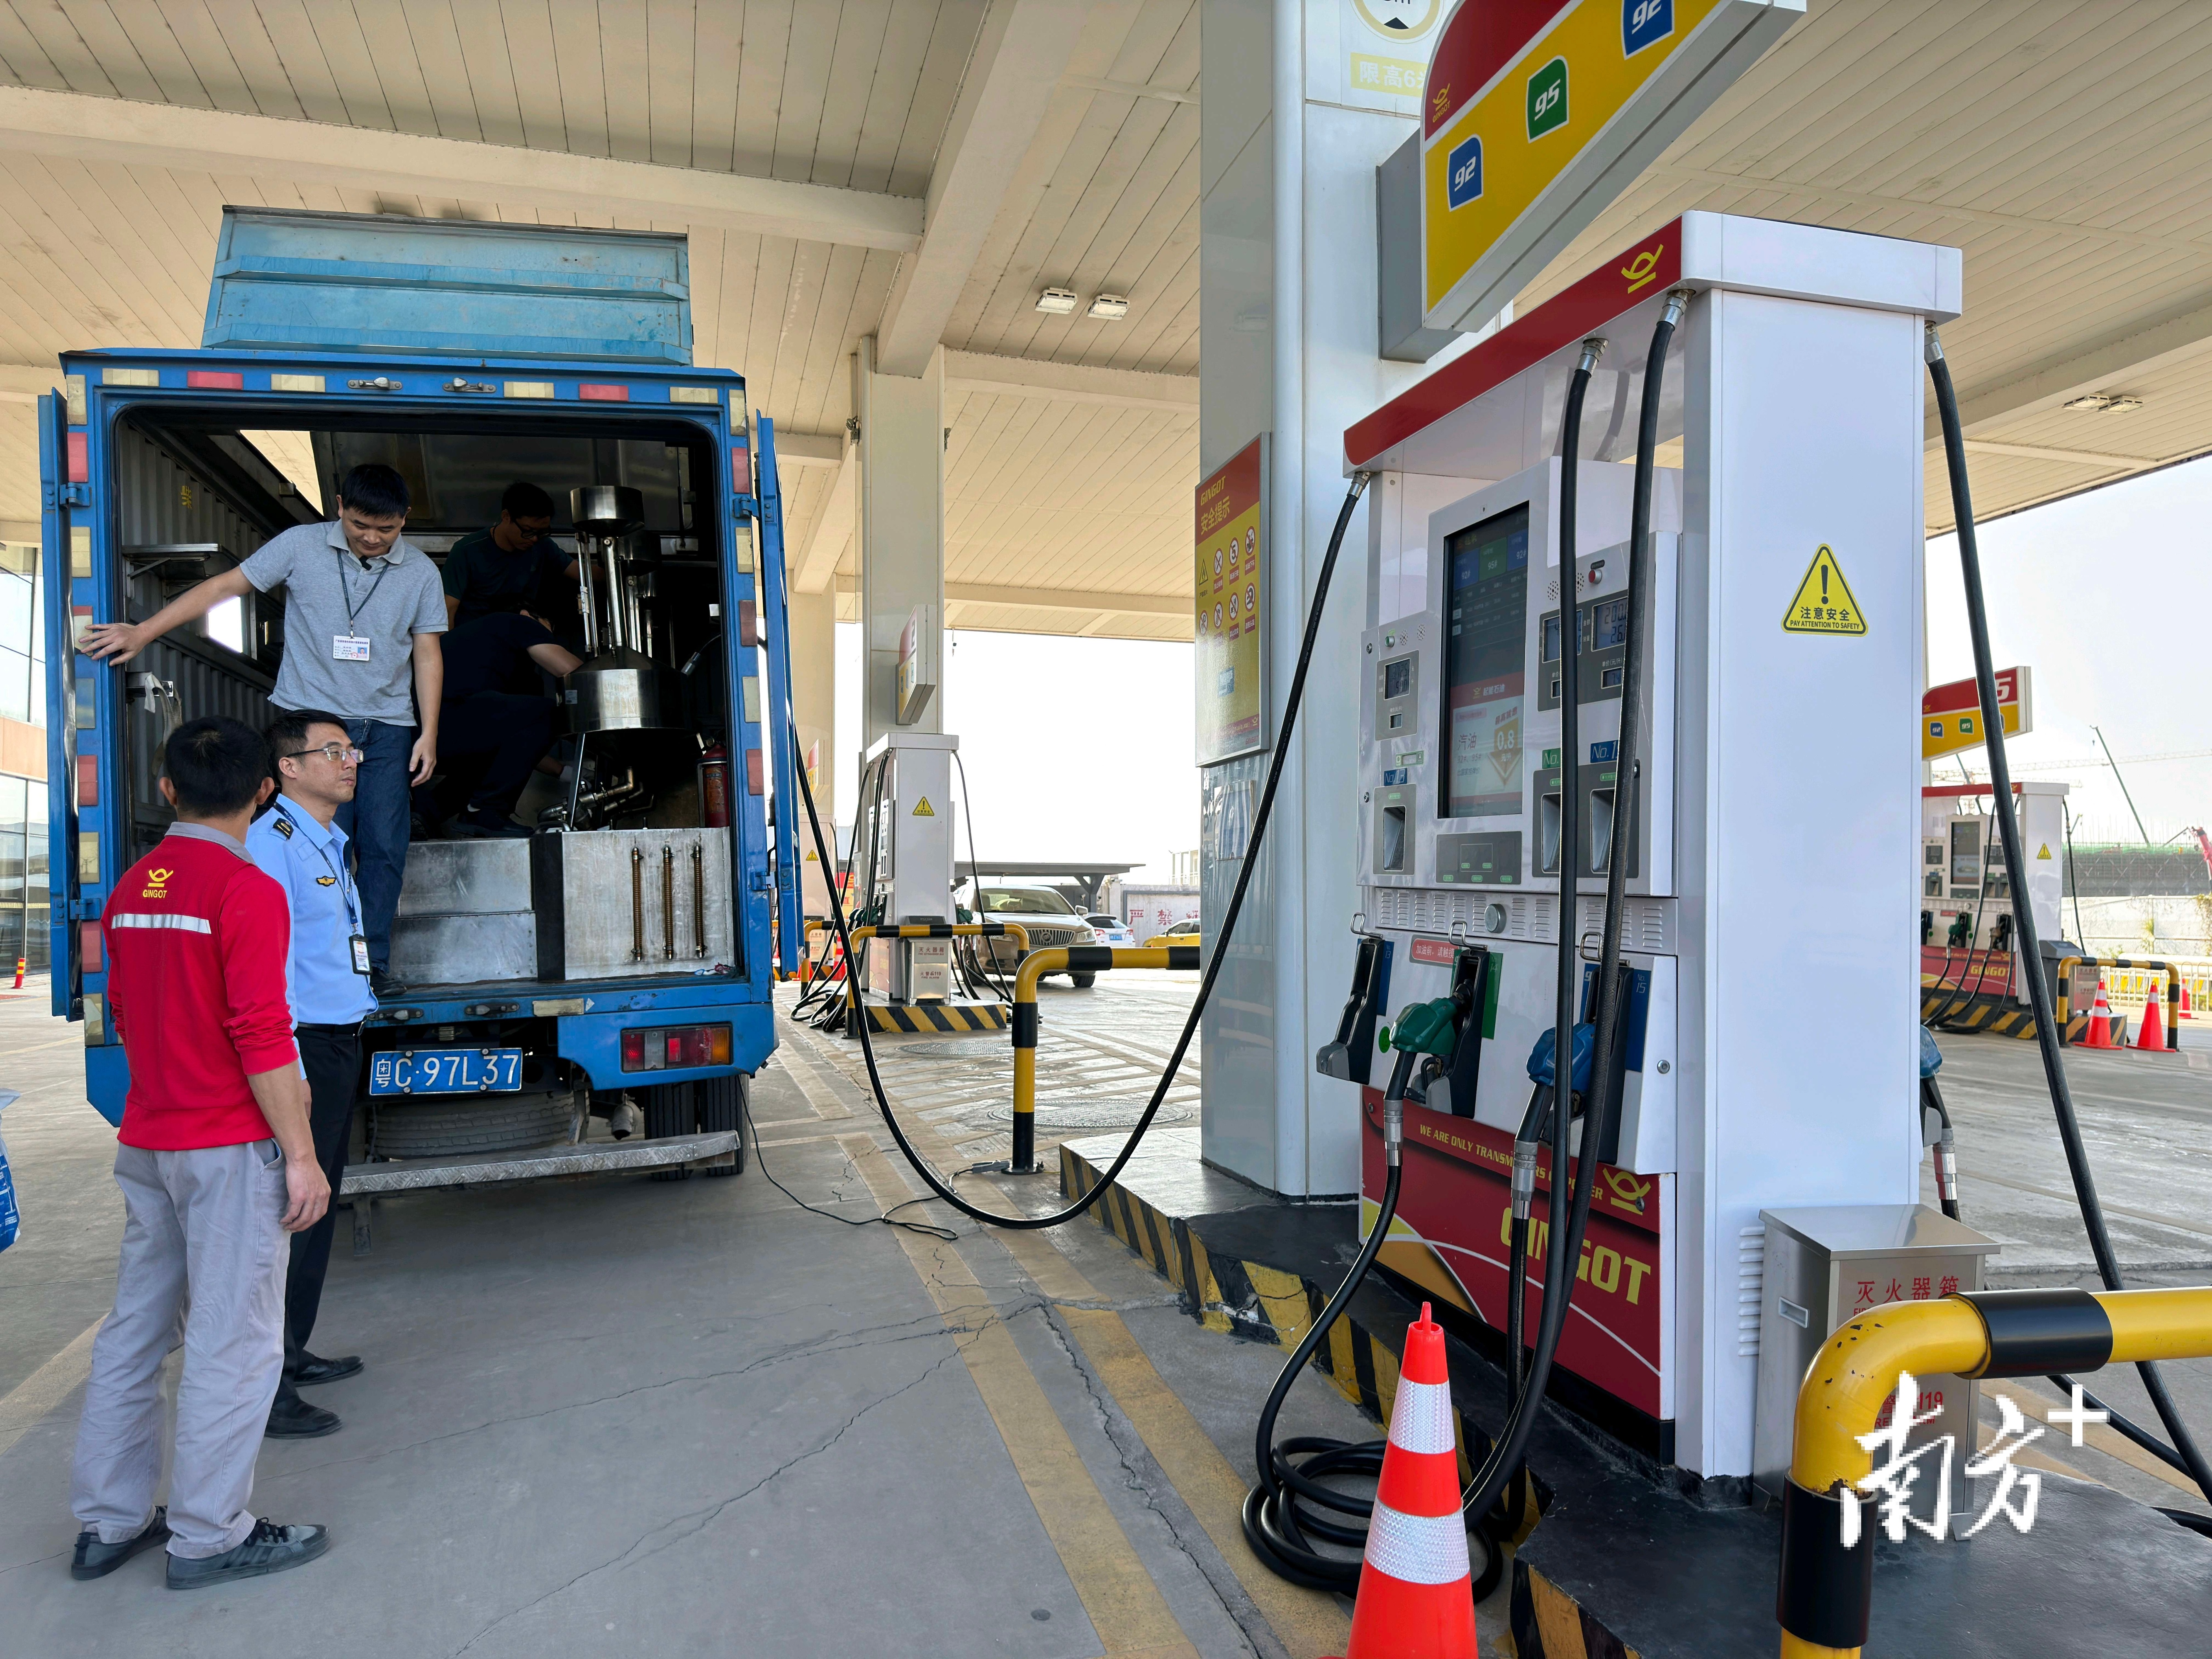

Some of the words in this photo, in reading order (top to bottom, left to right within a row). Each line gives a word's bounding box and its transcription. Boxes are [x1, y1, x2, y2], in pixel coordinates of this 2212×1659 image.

[1632, 0, 1662, 34] 92
[1534, 78, 1560, 121] 95
[1454, 156, 1476, 192] 92
[1201, 476, 1226, 506] GINGOT
[1201, 496, 1230, 535] 安全提示
[1516, 549, 1526, 559] 92#
[1488, 559, 1497, 571] 95#
[1462, 570, 1470, 580] 92#
[1604, 602, 1627, 624] 200.
[1801, 606, 1850, 621] 注意安全
[1611, 624, 1625, 643] 26.
[1495, 706, 1518, 725] 最高优惠
[1458, 732, 1477, 750] 汽油
[1497, 730, 1514, 750] 0.8
[1591, 741, 1618, 759] No.1
[143, 889, 168, 898] GINGOT
[1385, 951, 1391, 959] 13
[1584, 971, 1592, 982] 9
[1636, 983, 1647, 993] 15
[1420, 1124, 1431, 1137] WE
[1433, 1129, 1449, 1143] ARE
[1451, 1136, 1473, 1152] ONLY
[1476, 1144, 1545, 1179] TRANSMRS
[1855, 1275, 1959, 1304] 灭火器箱
[1919, 1391, 1944, 1410] 119
